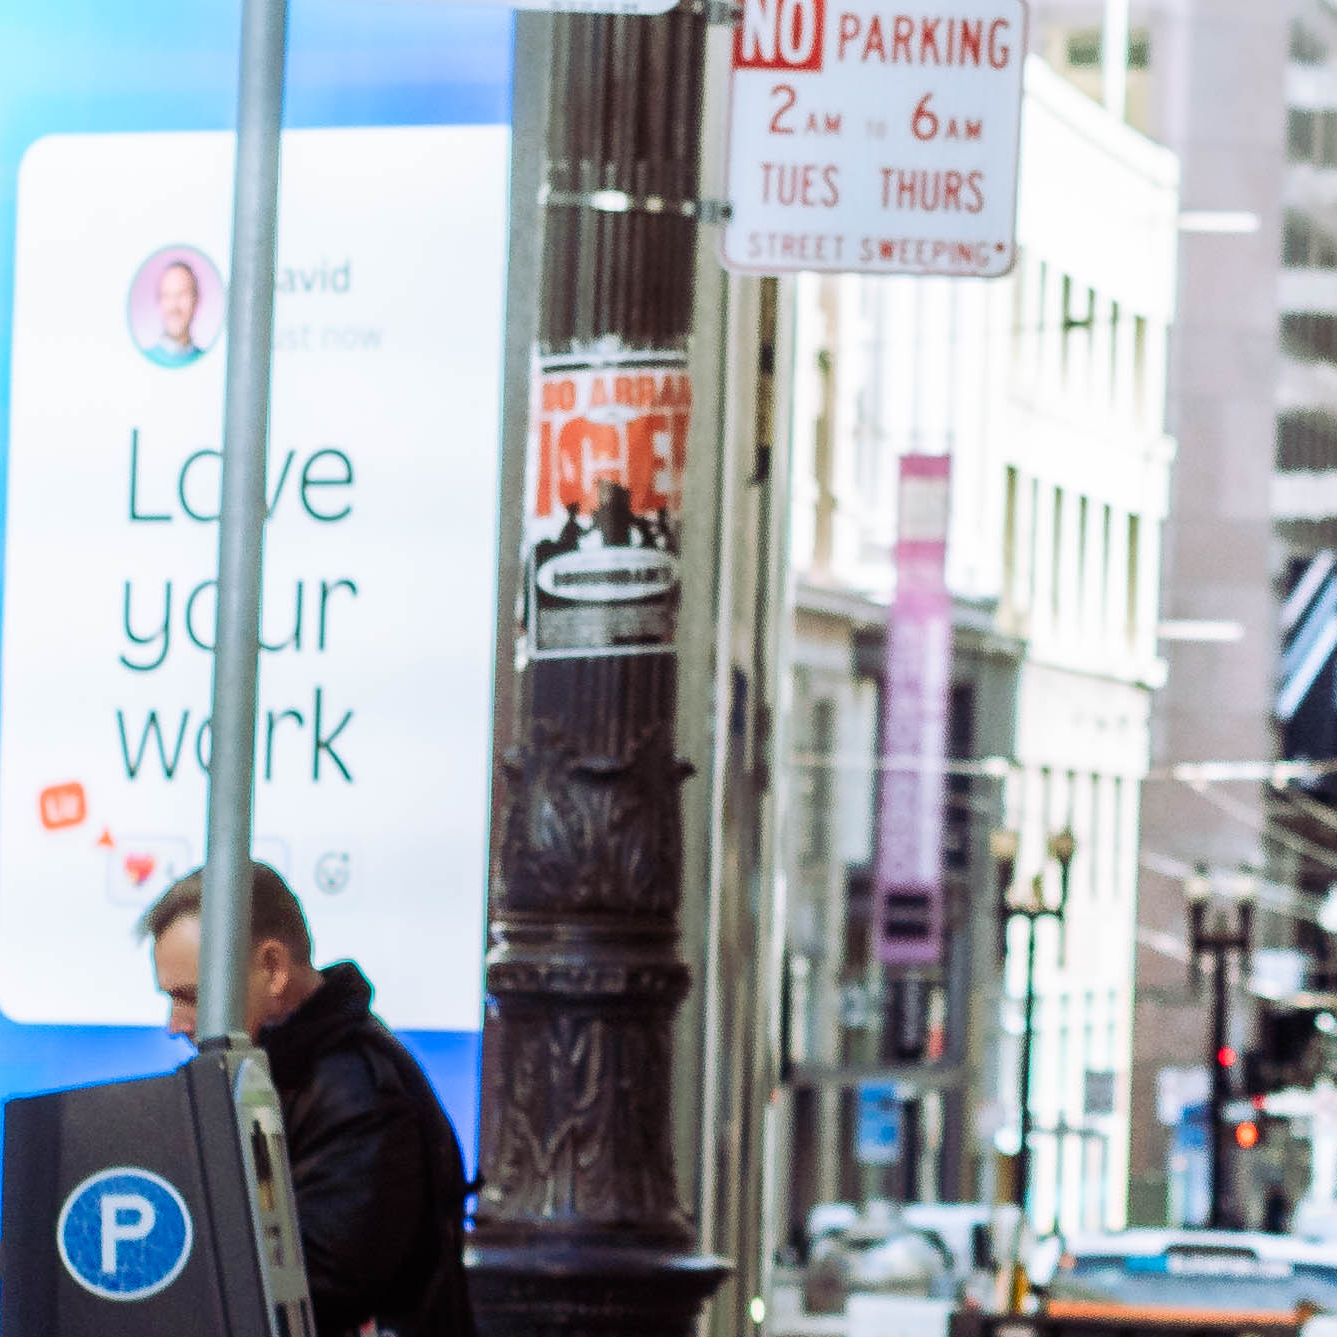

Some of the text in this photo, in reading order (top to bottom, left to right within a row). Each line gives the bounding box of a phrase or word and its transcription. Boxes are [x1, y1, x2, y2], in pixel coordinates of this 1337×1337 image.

[743, 0, 1010, 70] NO PARKING
[760, 164, 984, 214] TUES THURS
[748, 232, 844, 259] STREET
[272, 257, 351, 293] avid
[100, 1194, 157, 1276] P
